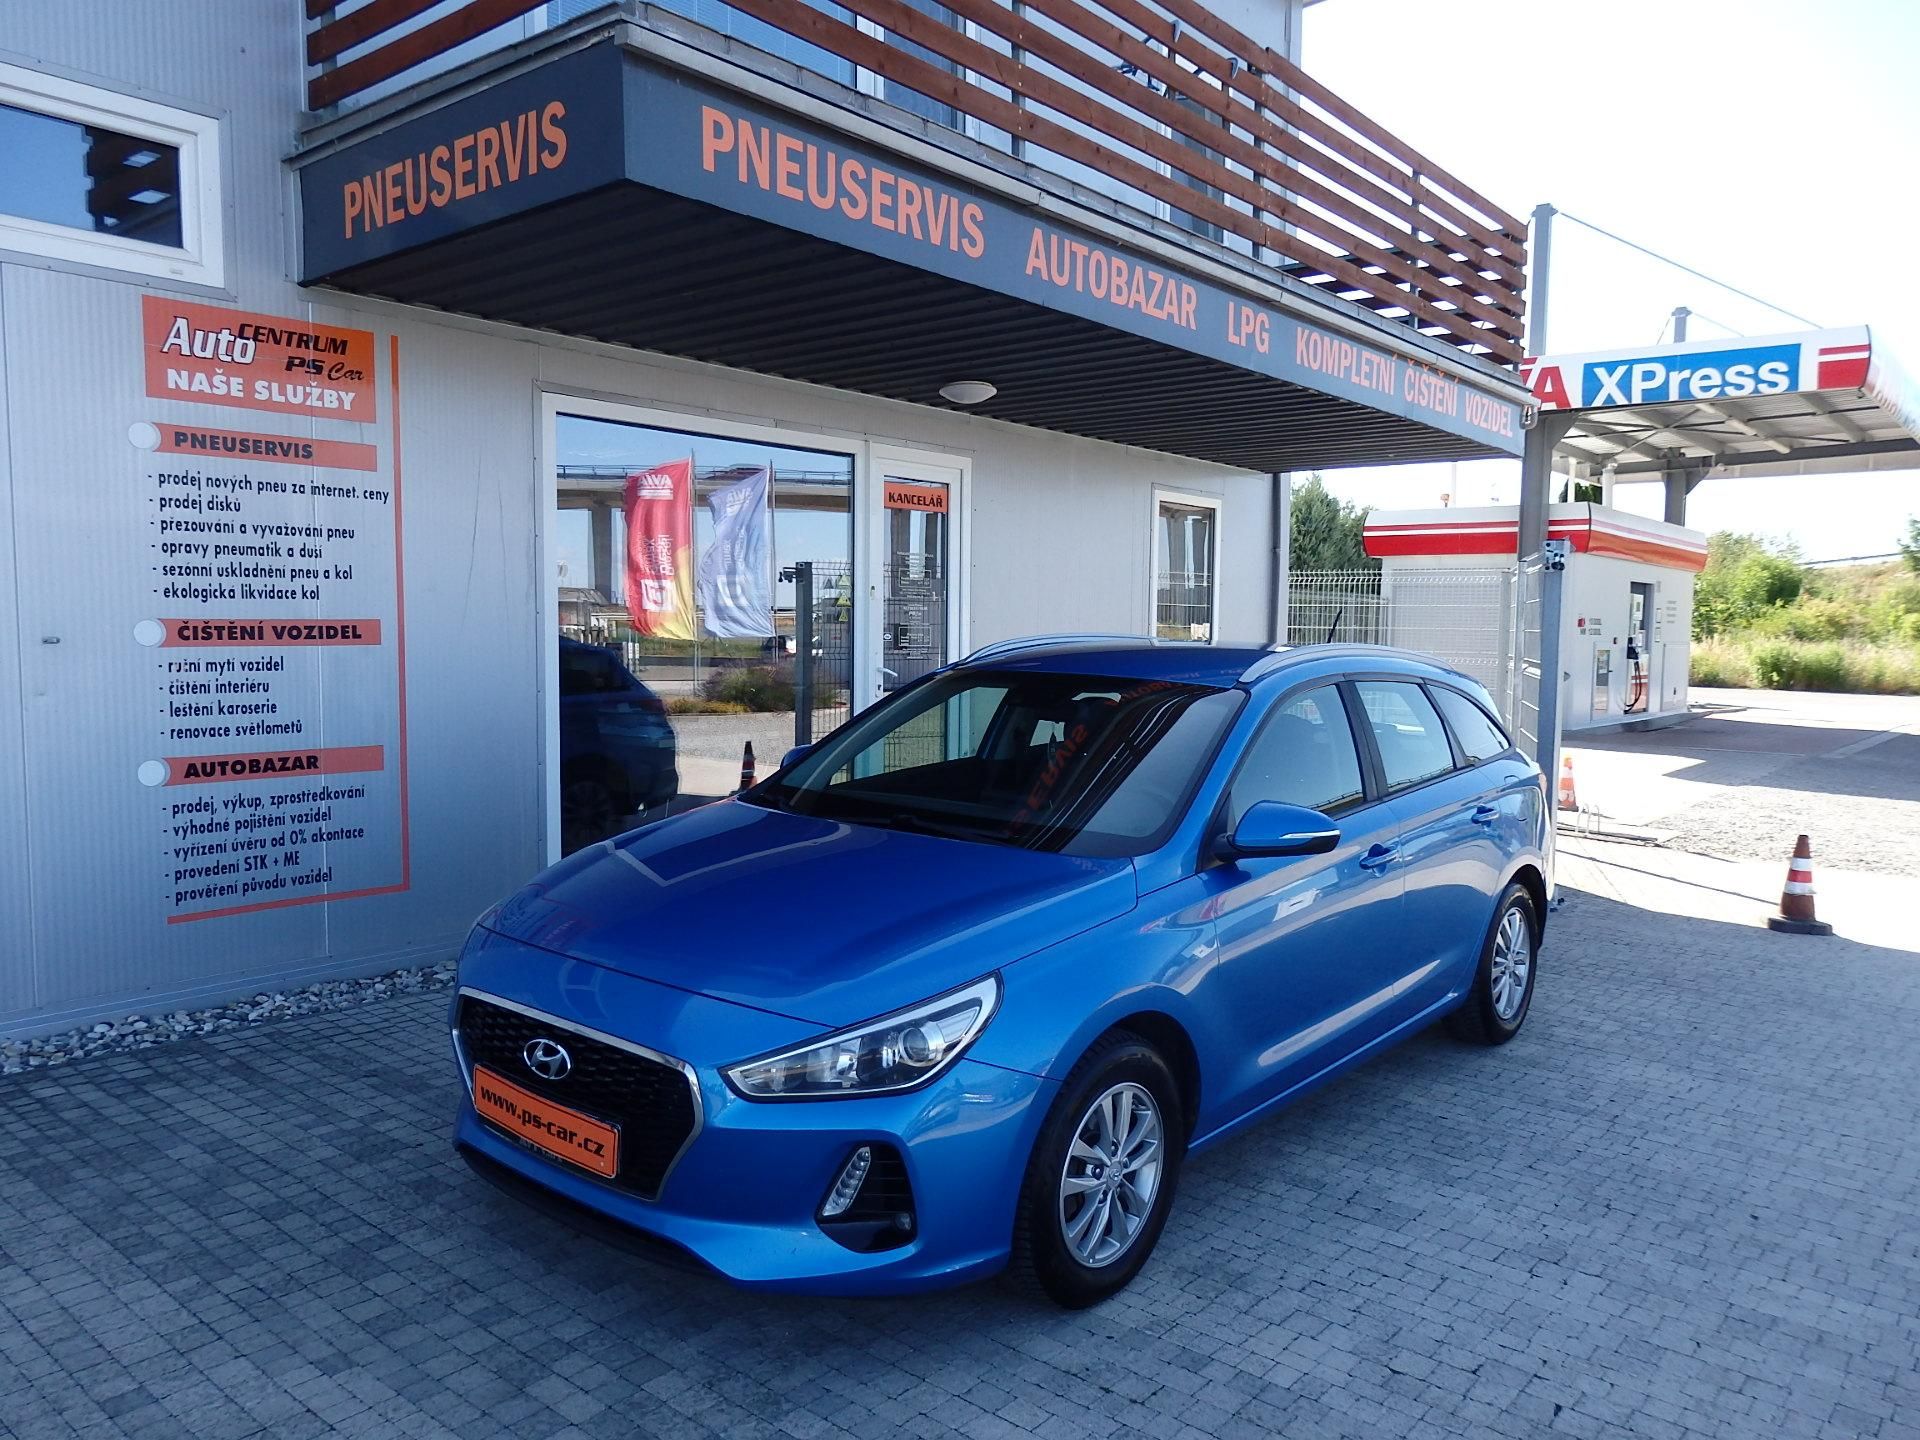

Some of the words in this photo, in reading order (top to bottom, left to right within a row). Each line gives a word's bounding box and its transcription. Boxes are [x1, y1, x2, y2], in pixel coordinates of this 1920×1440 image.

[343, 100, 567, 239] PNEUSERVIS
[701, 105, 985, 259] PNEUSERVIS
[1026, 227, 1198, 331] AUTOBAZAR
[1227, 301, 1270, 354] LPG
[1296, 325, 1398, 396] KOMPLETNÍ
[1404, 357, 1459, 417] ČIŠTĚNÍ
[1465, 391, 1513, 438] VOZIDEL
[160, 316, 256, 364] Auto
[238, 323, 348, 355] CENTRUM
[285, 355, 325, 376] PS
[327, 362, 364, 381] Car
[167, 368, 243, 398] NAŠE
[255, 380, 355, 411] SLUŽBY
[1593, 361, 1790, 406] XPress
[175, 431, 313, 459] PNEUSERVIS
[158, 470, 201, 490] prodej
[207, 475, 252, 492] nových
[258, 481, 286, 495] pneu
[292, 483, 305, 494] za
[363, 489, 389, 504] ceny
[888, 491, 943, 508] KANCELÁŘ
[159, 494, 201, 514] prodej
[161, 517, 234, 535] přezouvání
[240, 522, 247, 534] a
[253, 522, 322, 539] vyvažování
[327, 528, 354, 540] pneu
[161, 543, 209, 558] opravy
[215, 542, 282, 559] pneumatik
[287, 546, 294, 557] a
[299, 544, 322, 559] duší
[162, 562, 212, 577] sezónní
[217, 562, 285, 579] uskladnění
[291, 568, 318, 582] pneu
[323, 568, 330, 579] a
[335, 565, 352, 580] kol
[164, 582, 235, 603] ekologická
[241, 583, 296, 600] likvidace
[302, 584, 319, 600] kol
[178, 620, 264, 642] ČIŠTĚNÍ
[272, 625, 361, 640] VOZIDEL
[240, 656, 284, 672] vozidel
[169, 679, 210, 695] čištění
[215, 678, 269, 694] interiéru
[170, 701, 213, 718] leštění
[218, 699, 277, 716] karoserie
[170, 723, 230, 739] renovace
[236, 720, 302, 737] světlometů
[184, 755, 319, 779] AUTOBAZAR
[172, 796, 217, 819] prodej,
[270, 784, 365, 808] zprostředkování
[173, 817, 229, 837] výhodné
[235, 813, 285, 834] pojištění
[290, 806, 331, 824] vozidel
[174, 838, 227, 862] vyřízení
[232, 835, 266, 853] úvěru
[271, 832, 285, 847] od
[290, 830, 307, 845] 0%
[311, 827, 364, 843] akontace
[174, 859, 240, 884] provedení
[244, 855, 268, 872] STK
[283, 851, 300, 866] ME
[175, 883, 238, 906] prověření
[242, 876, 286, 896] původu
[291, 867, 332, 886] vozidel
[480, 1086, 605, 1158] www.ps-car.cz
